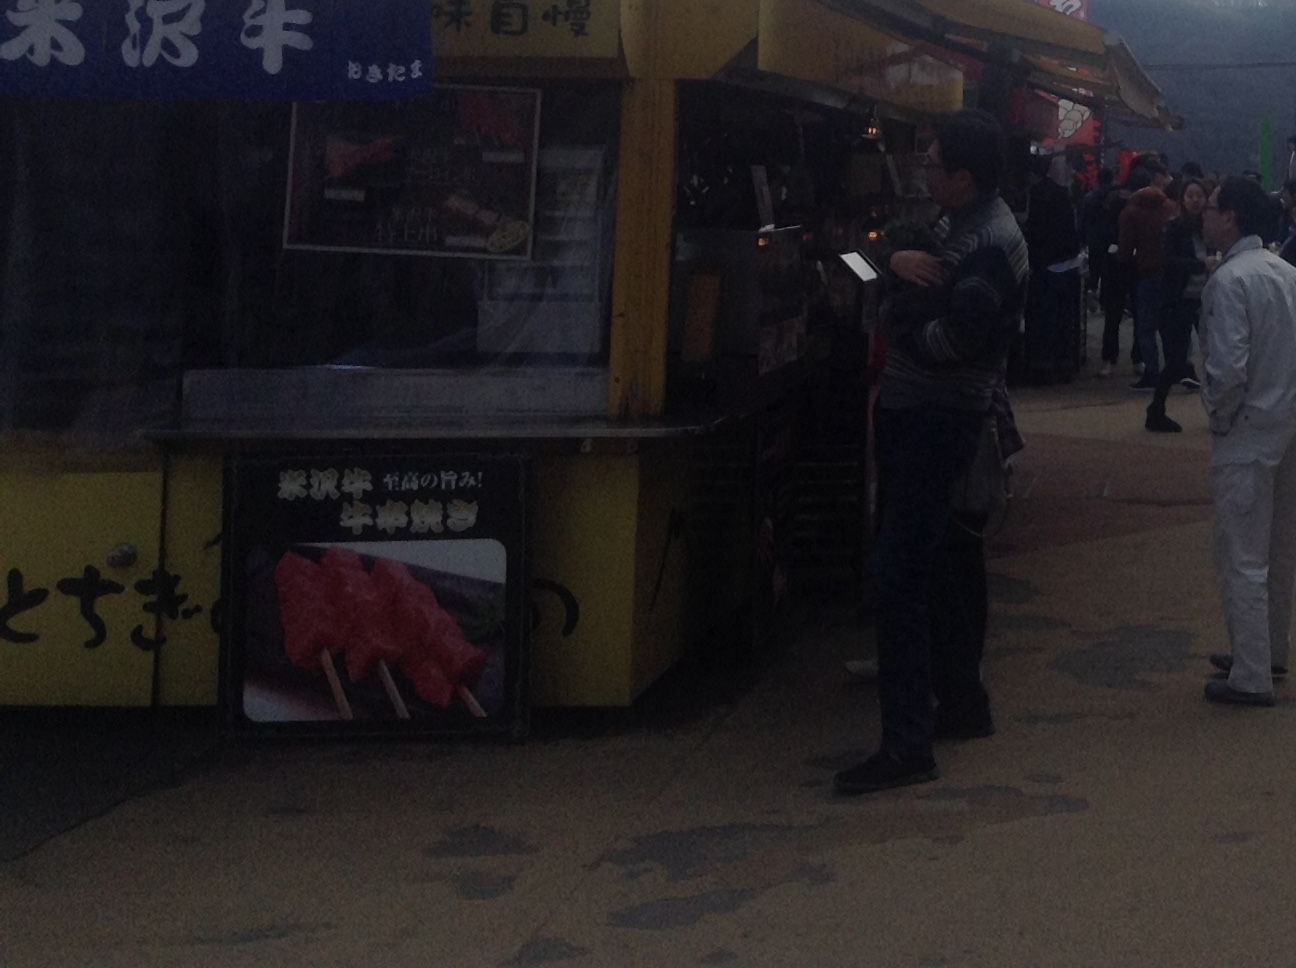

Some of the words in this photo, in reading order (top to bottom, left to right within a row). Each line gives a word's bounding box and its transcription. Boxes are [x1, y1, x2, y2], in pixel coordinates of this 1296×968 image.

[347, 58, 423, 84] おきたま
[277, 467, 374, 502] 米沢牛
[0, 532, 226, 651] とちぎ
